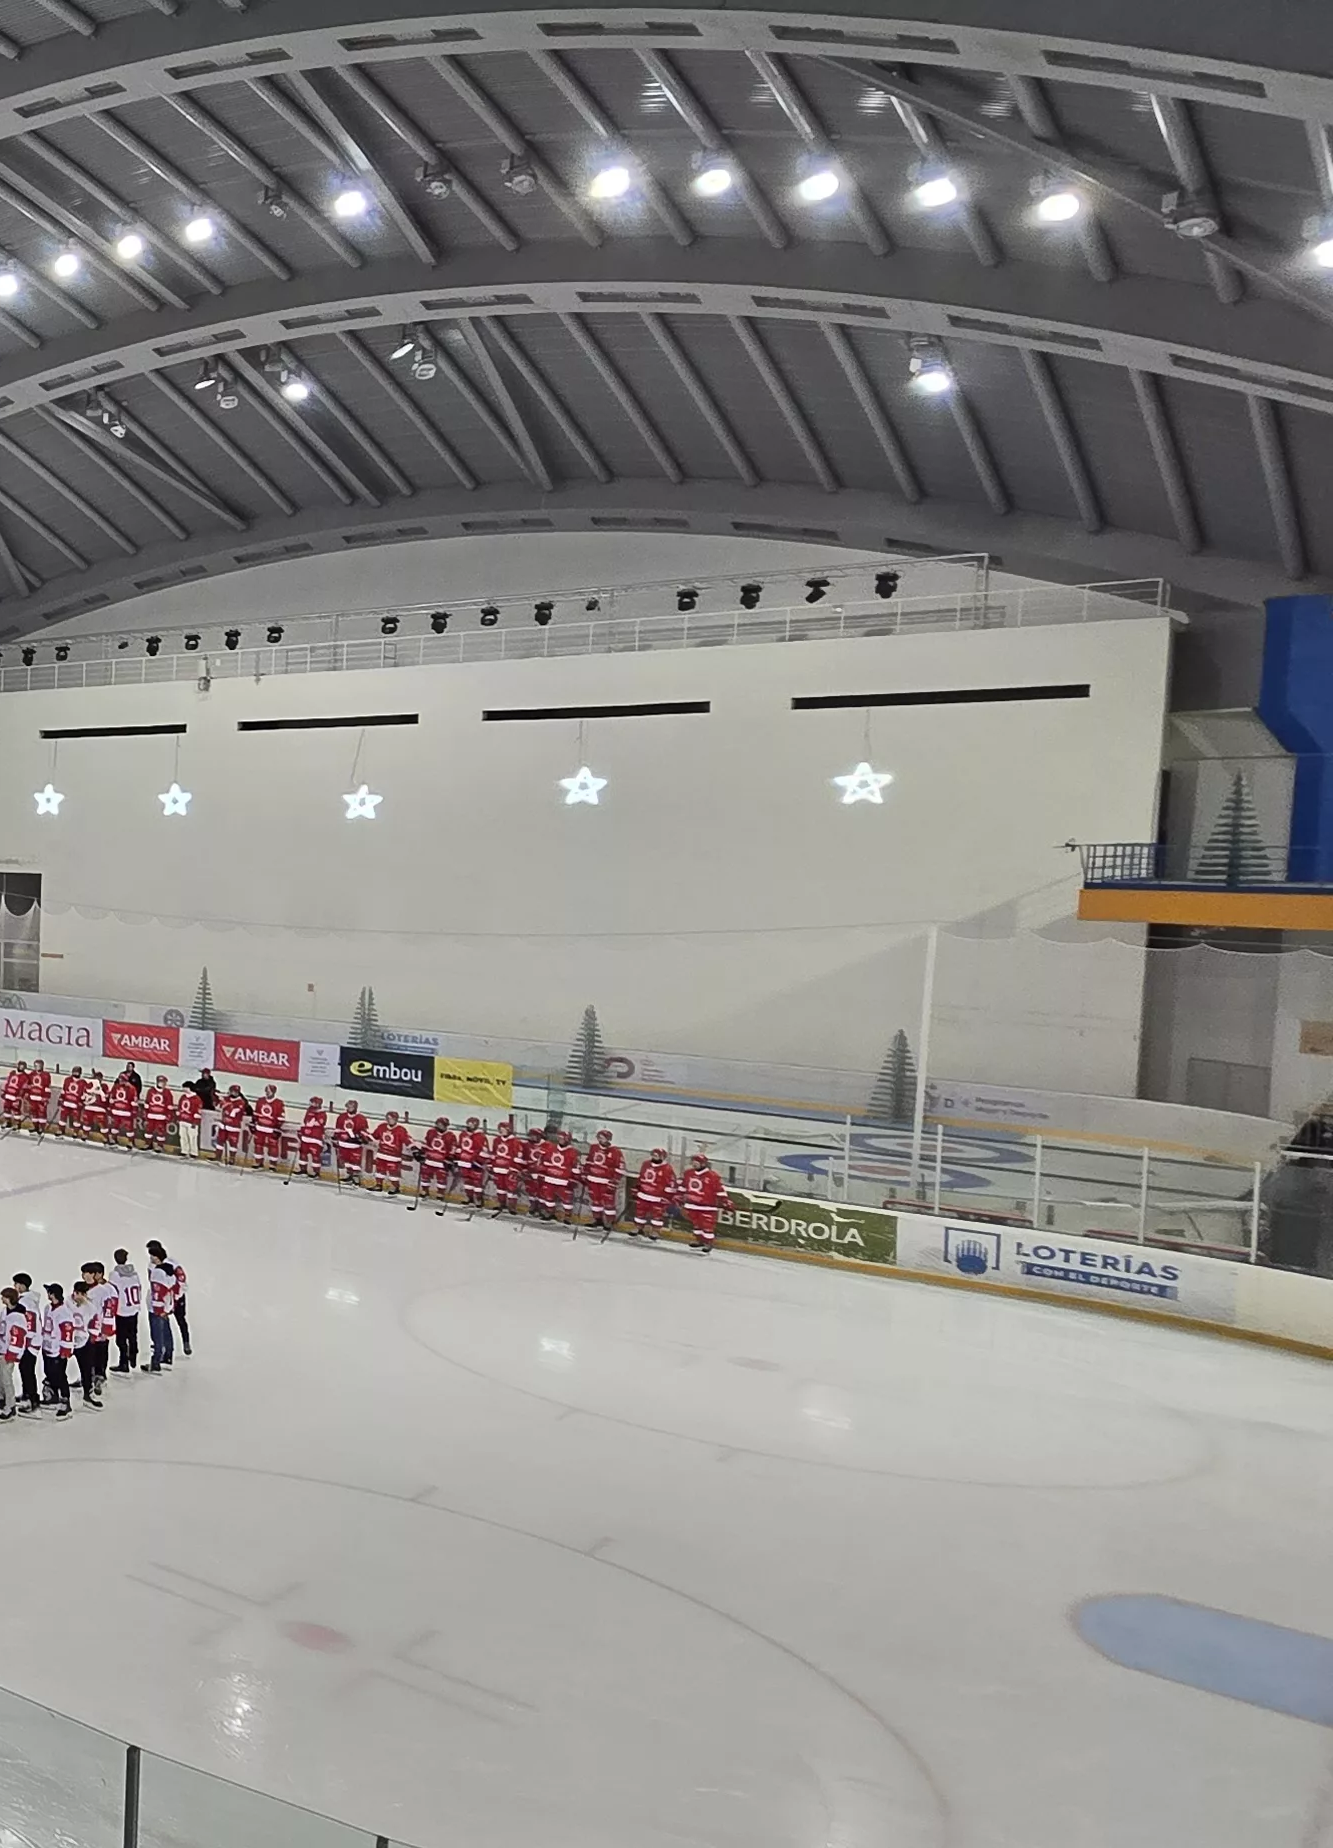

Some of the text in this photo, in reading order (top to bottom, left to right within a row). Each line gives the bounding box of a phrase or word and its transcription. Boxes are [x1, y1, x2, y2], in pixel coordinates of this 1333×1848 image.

[121, 1034, 171, 1052] AMBAR
[234, 1048, 291, 1067] AMBAR
[349, 1060, 423, 1083] embou
[717, 1209, 866, 1248] BERDROLA
[1015, 1241, 1183, 1282] LOTERÍAS
[124, 1285, 141, 1307] 10
